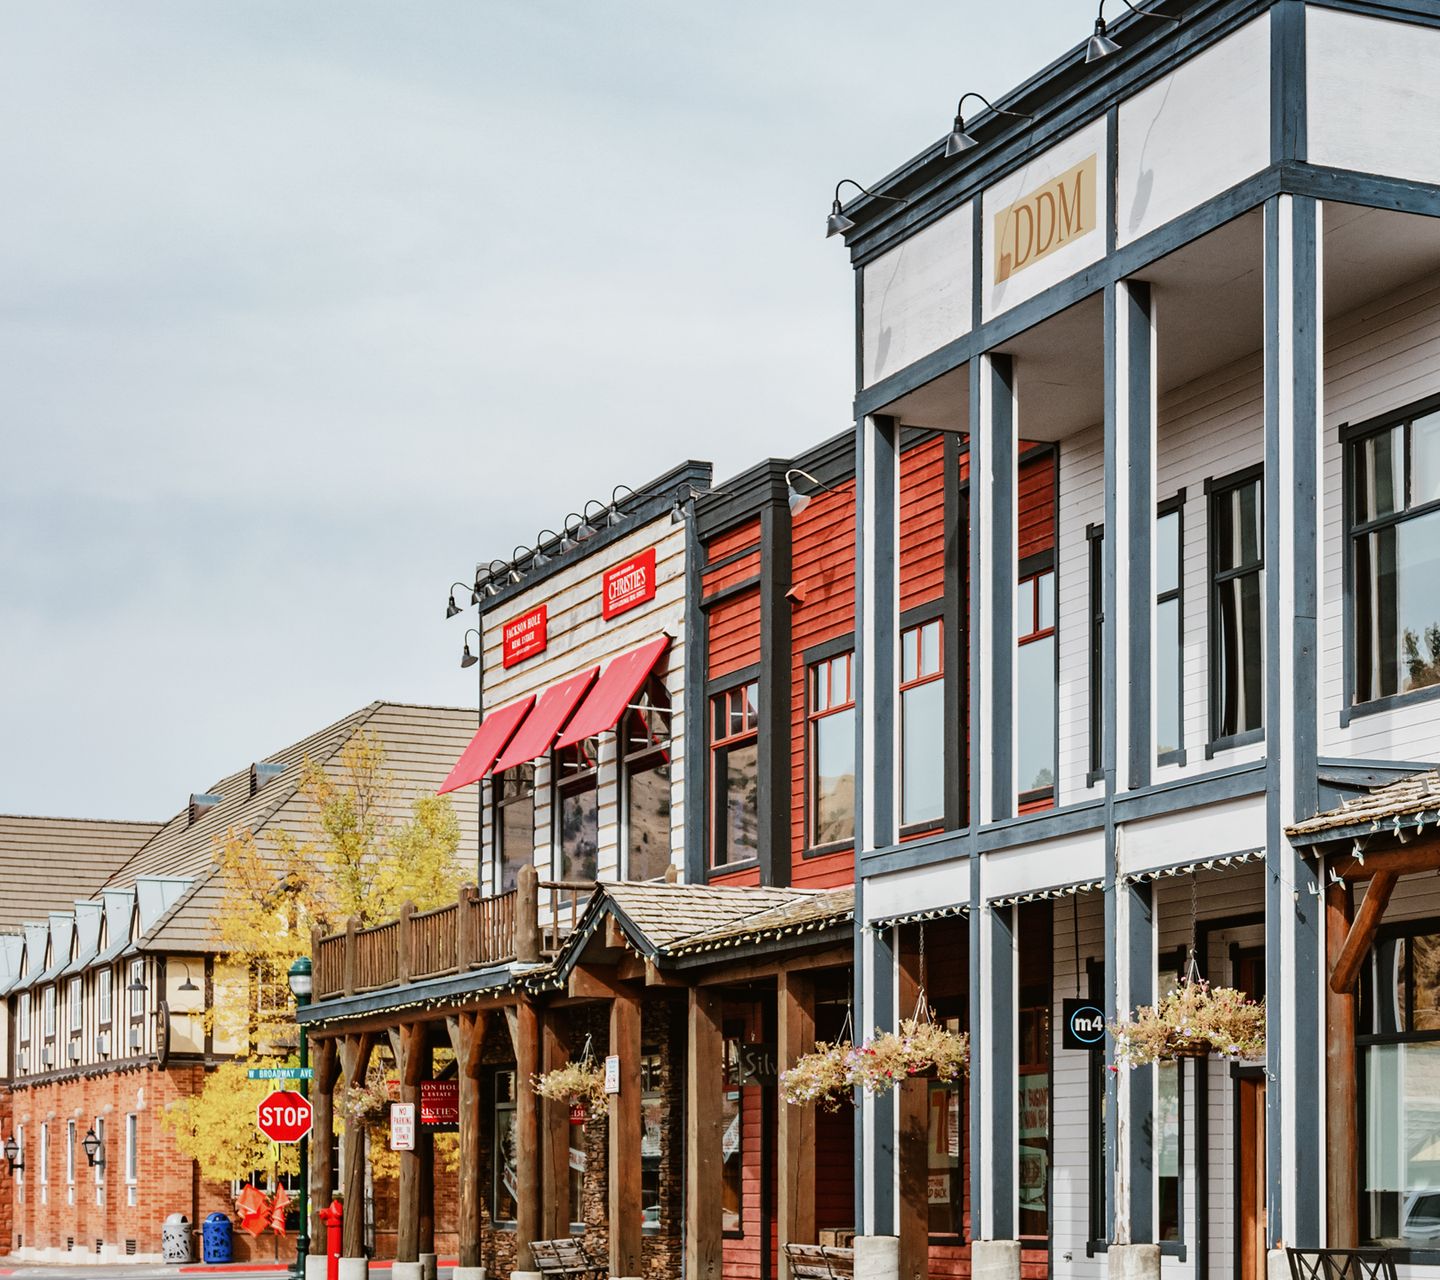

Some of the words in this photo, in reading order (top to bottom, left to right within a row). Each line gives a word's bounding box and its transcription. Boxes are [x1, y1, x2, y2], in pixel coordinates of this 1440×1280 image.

[1012, 169, 1084, 270] DDM
[505, 620, 527, 643] JACKSON
[527, 613, 541, 629] HOLE
[1075, 1015, 1103, 1031] m4
[248, 1070, 255, 1078] W
[259, 1070, 295, 1078] BROADWAY
[300, 1069, 313, 1077] AVE
[261, 1106, 309, 1127] STOP
